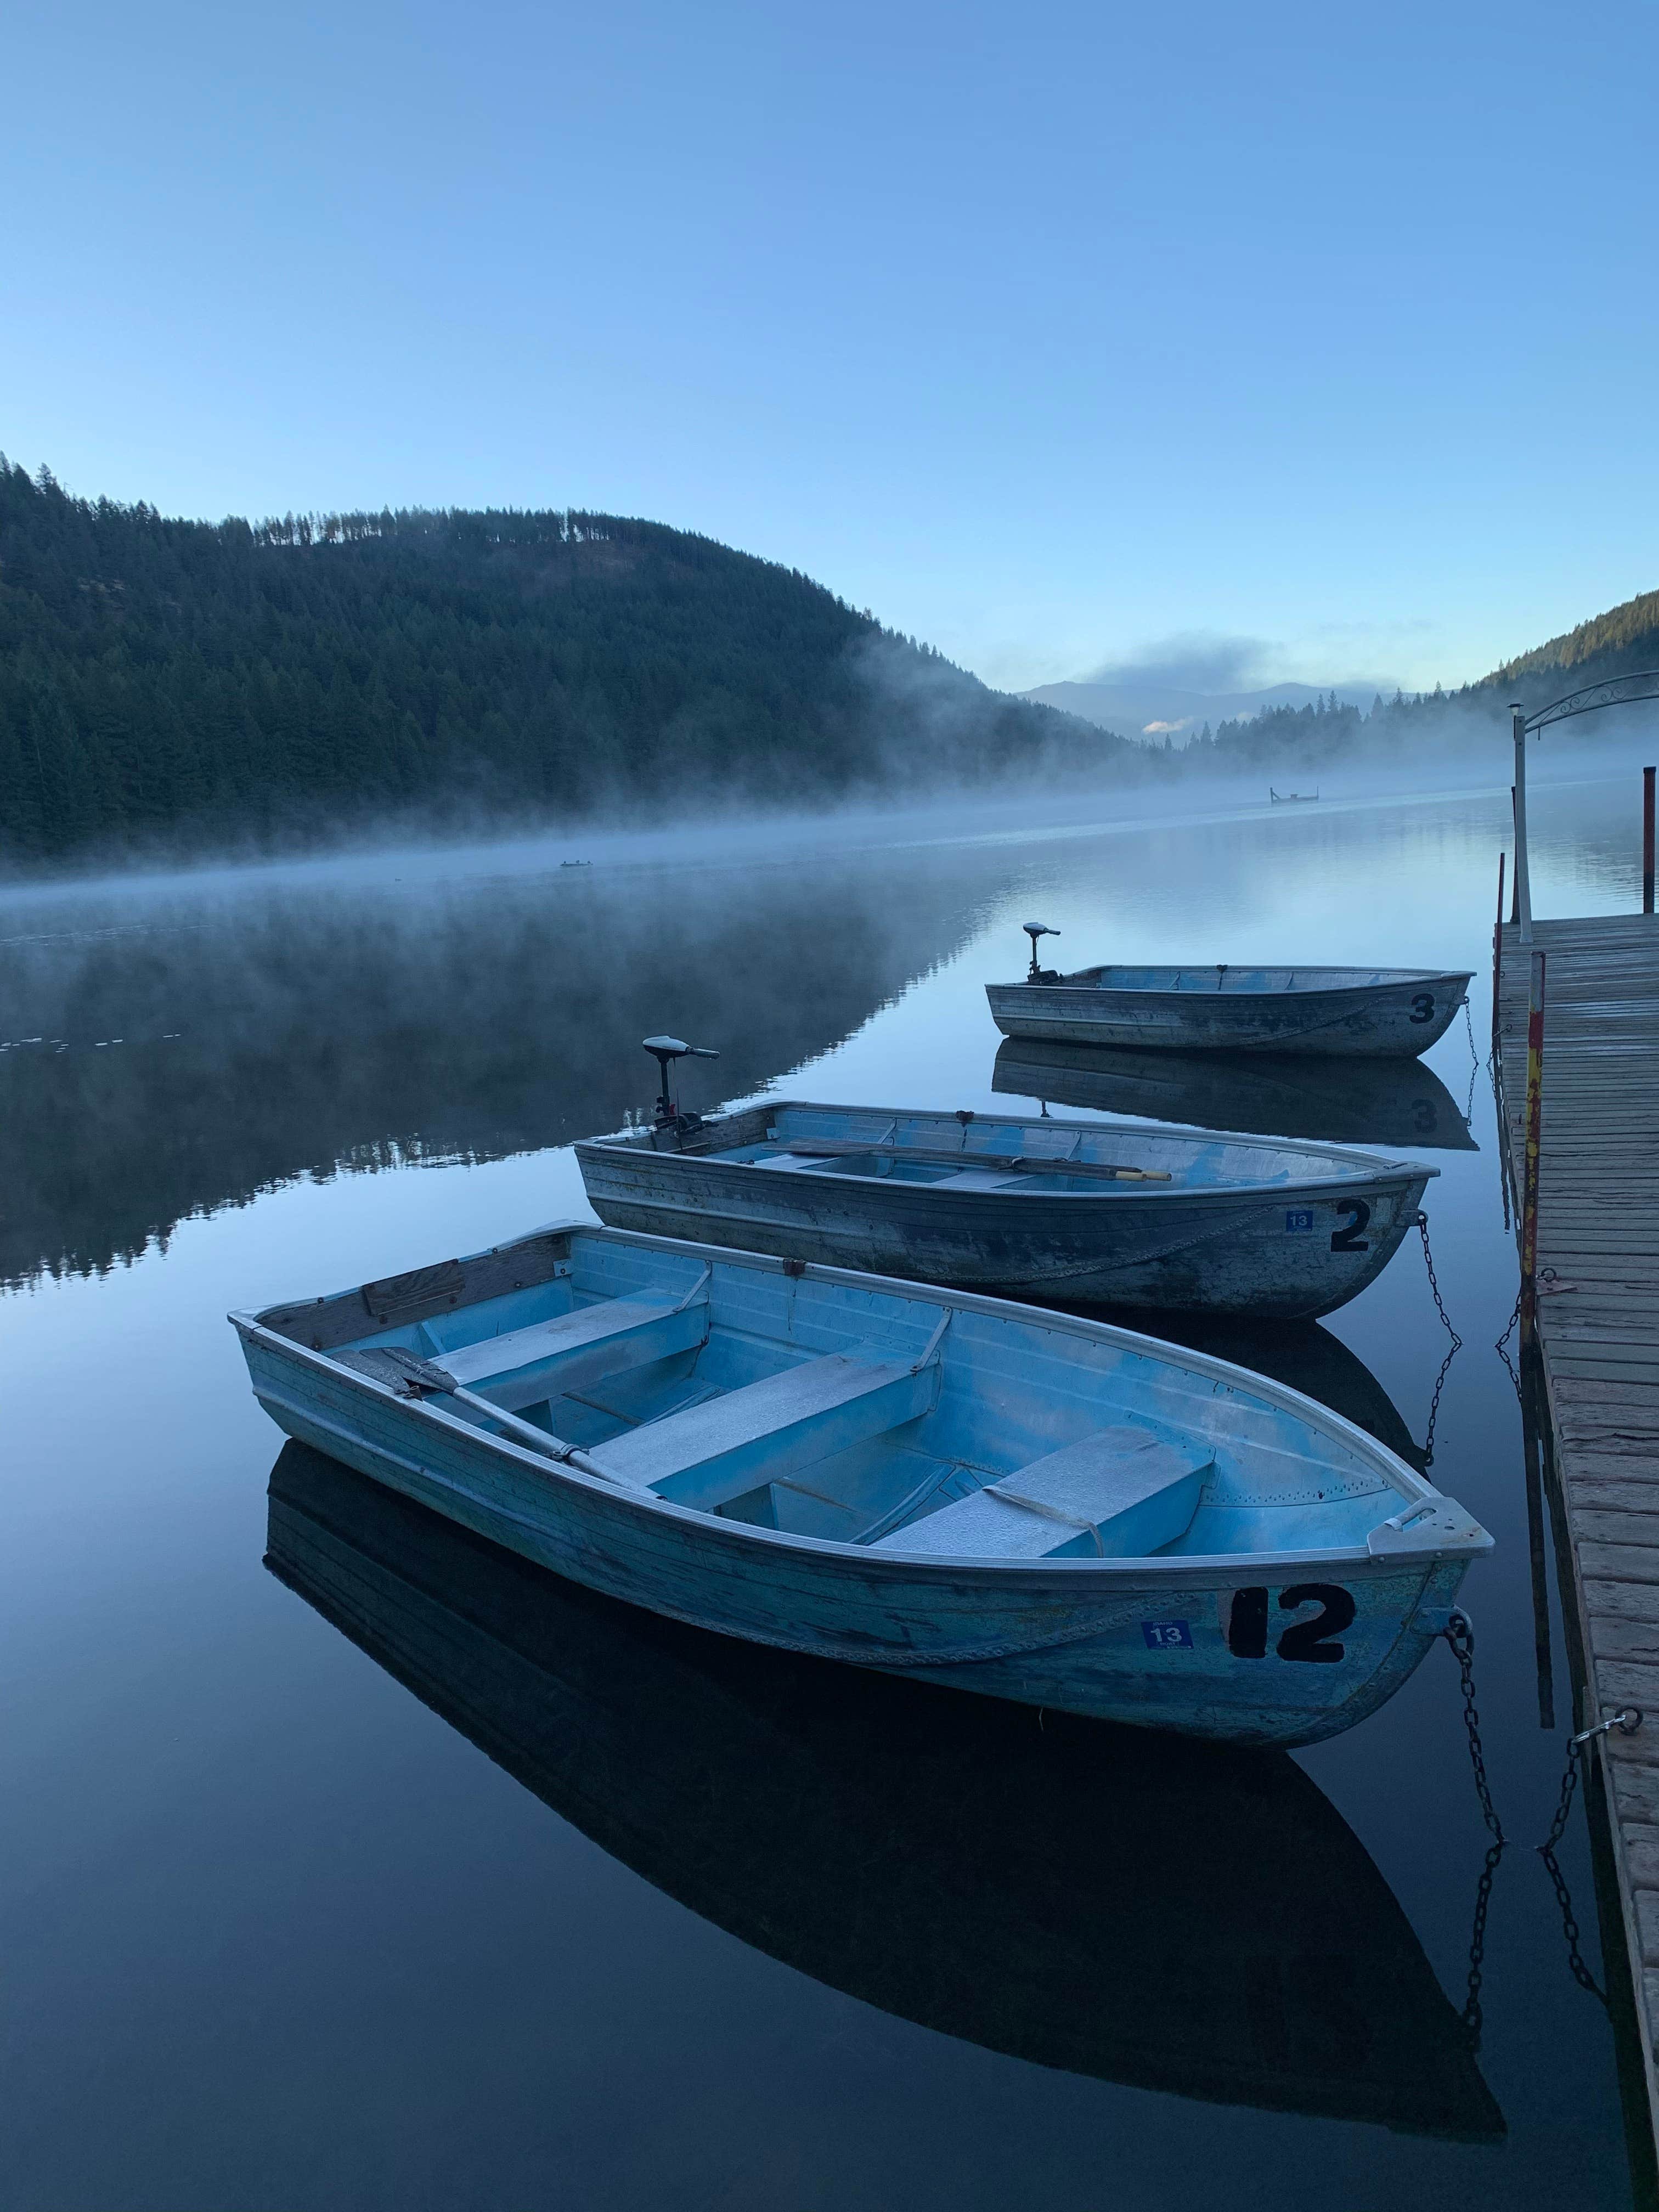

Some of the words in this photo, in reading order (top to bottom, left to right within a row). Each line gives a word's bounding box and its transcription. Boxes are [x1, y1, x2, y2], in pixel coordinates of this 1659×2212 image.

[1409, 993, 1435, 1024] 3
[1290, 1215, 1307, 1226] 13
[1331, 1199, 1370, 1252] 2
[1150, 1627, 1182, 1642] 13
[1230, 1584, 1355, 1662] 12
